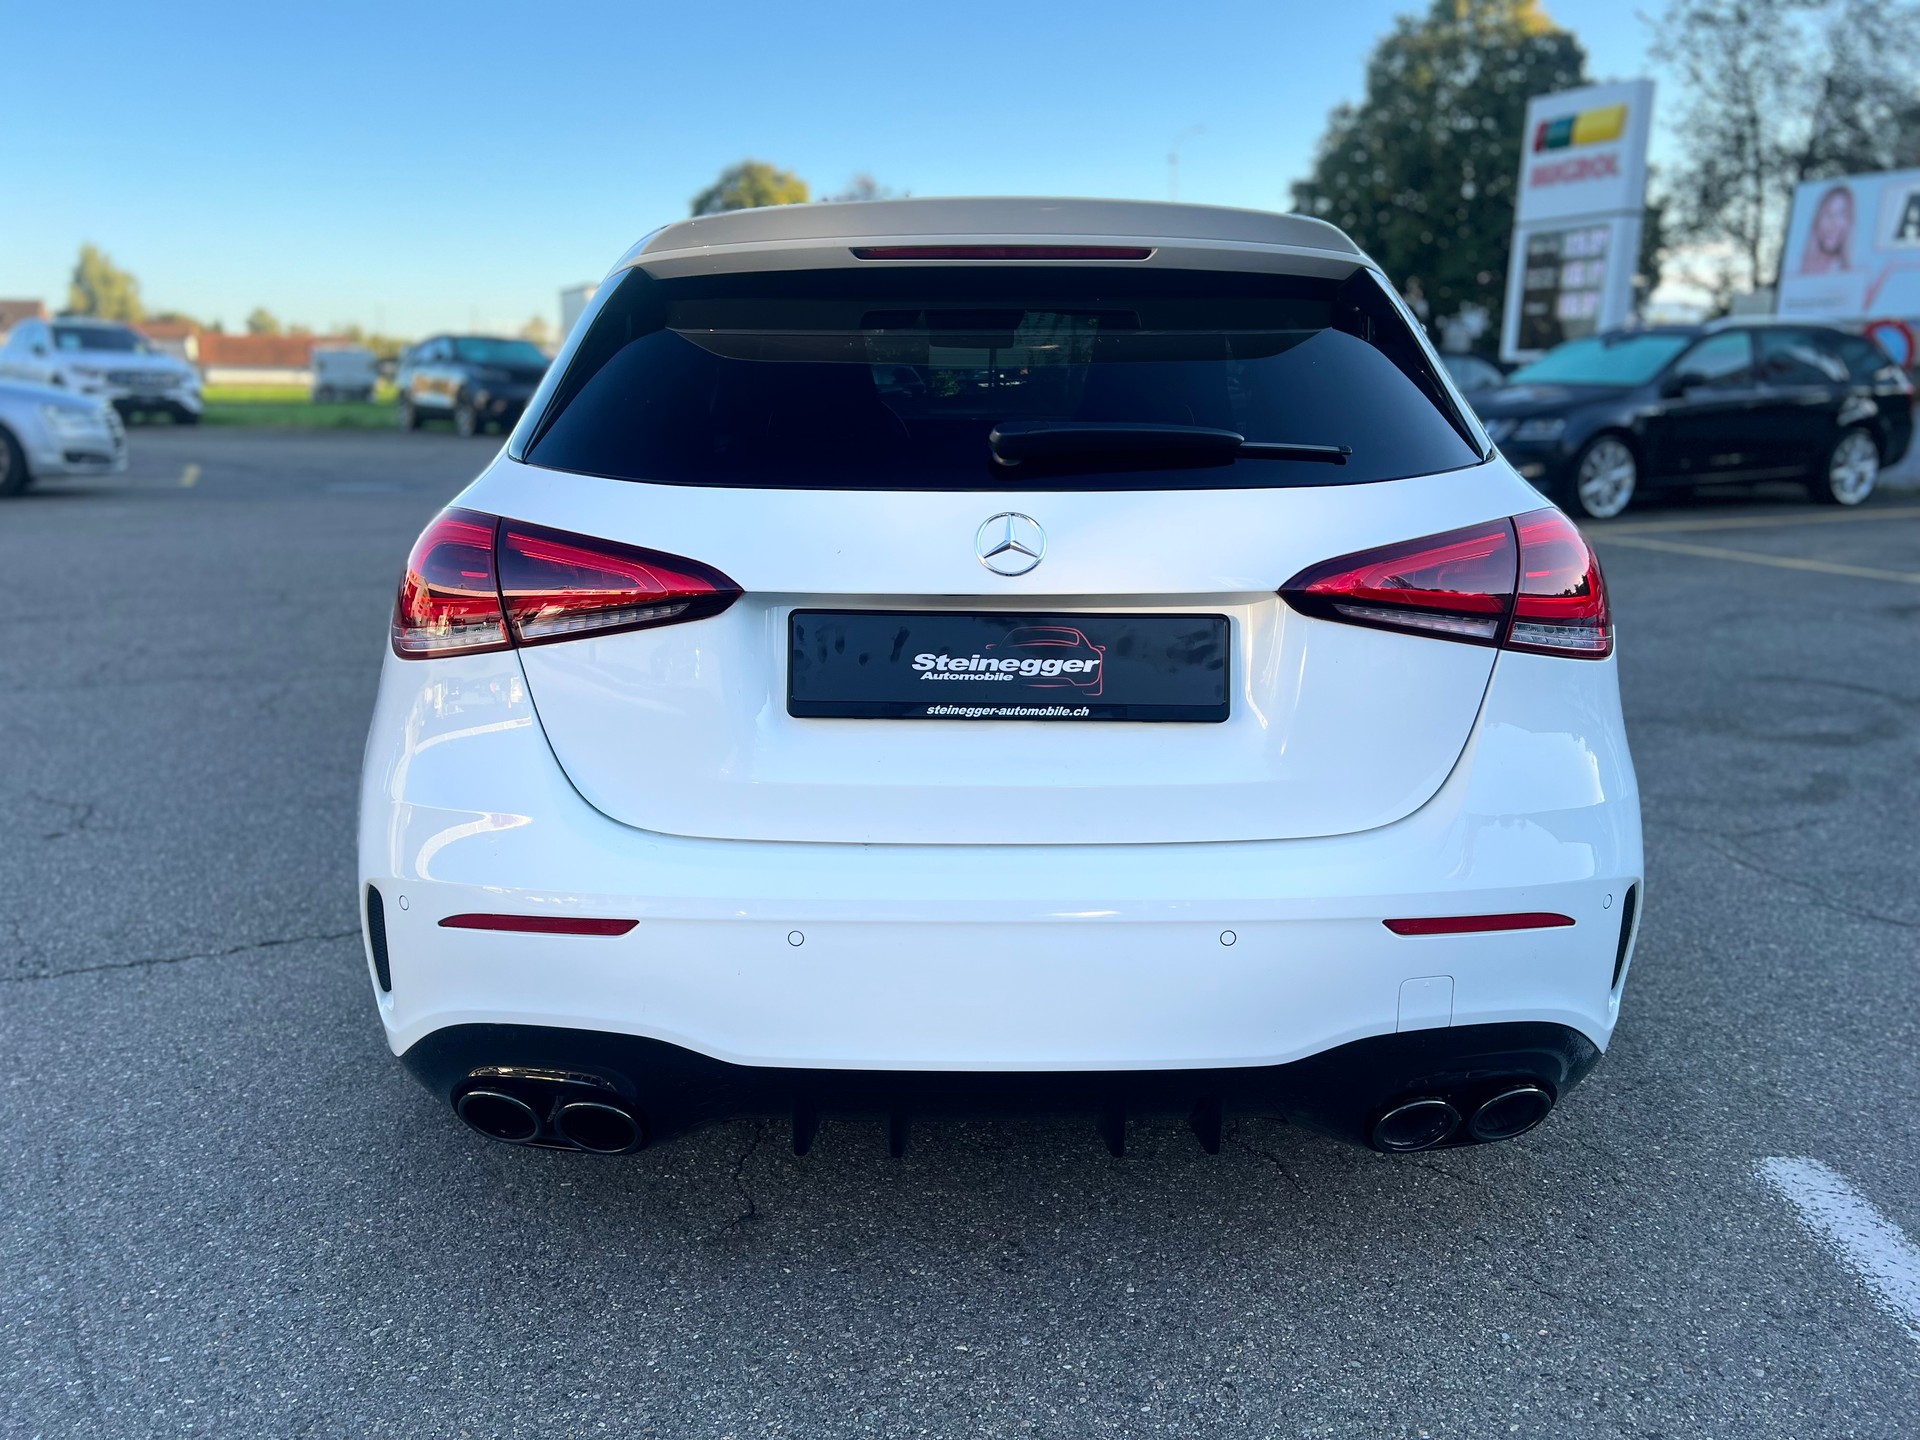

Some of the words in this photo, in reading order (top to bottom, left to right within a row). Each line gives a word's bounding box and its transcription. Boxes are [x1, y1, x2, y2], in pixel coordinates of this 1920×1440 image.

[911, 653, 1100, 677] Steinegger
[920, 671, 1014, 682] Automobile
[926, 705, 1090, 718] steinegger-automobile.ch
